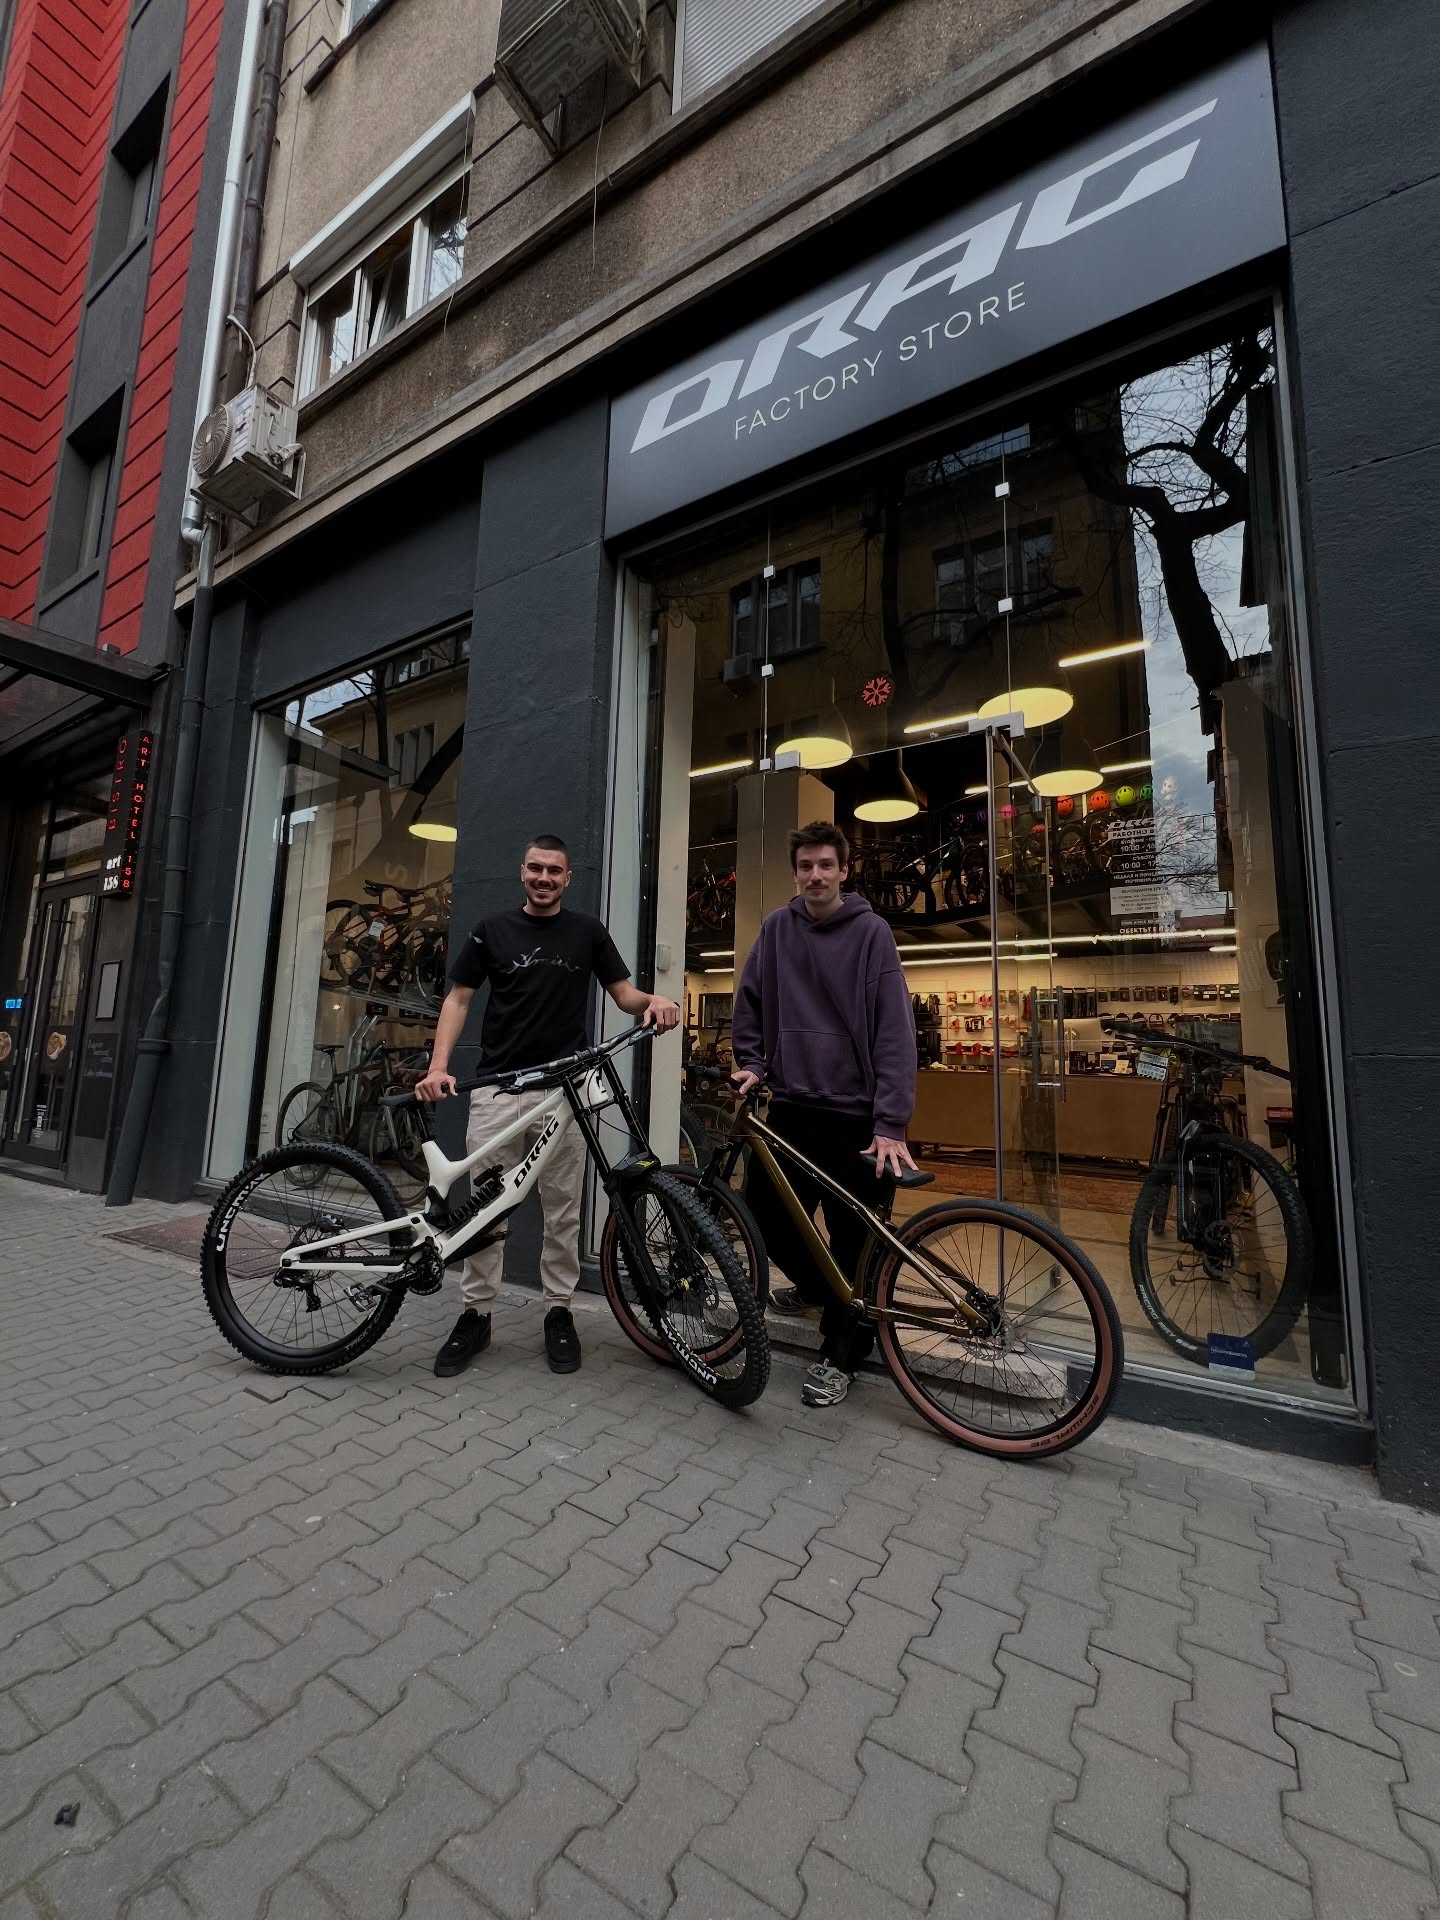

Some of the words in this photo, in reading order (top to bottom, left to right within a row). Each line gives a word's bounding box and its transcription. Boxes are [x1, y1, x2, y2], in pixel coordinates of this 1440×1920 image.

[629, 98, 1219, 455] DRAG
[733, 355, 884, 442] FACTORY
[898, 280, 1029, 360] STORE
[140, 736, 151, 768] ART
[130, 783, 144, 839] HOTEL
[122, 855, 132, 888] 158
[513, 1117, 560, 1189] DRAG
